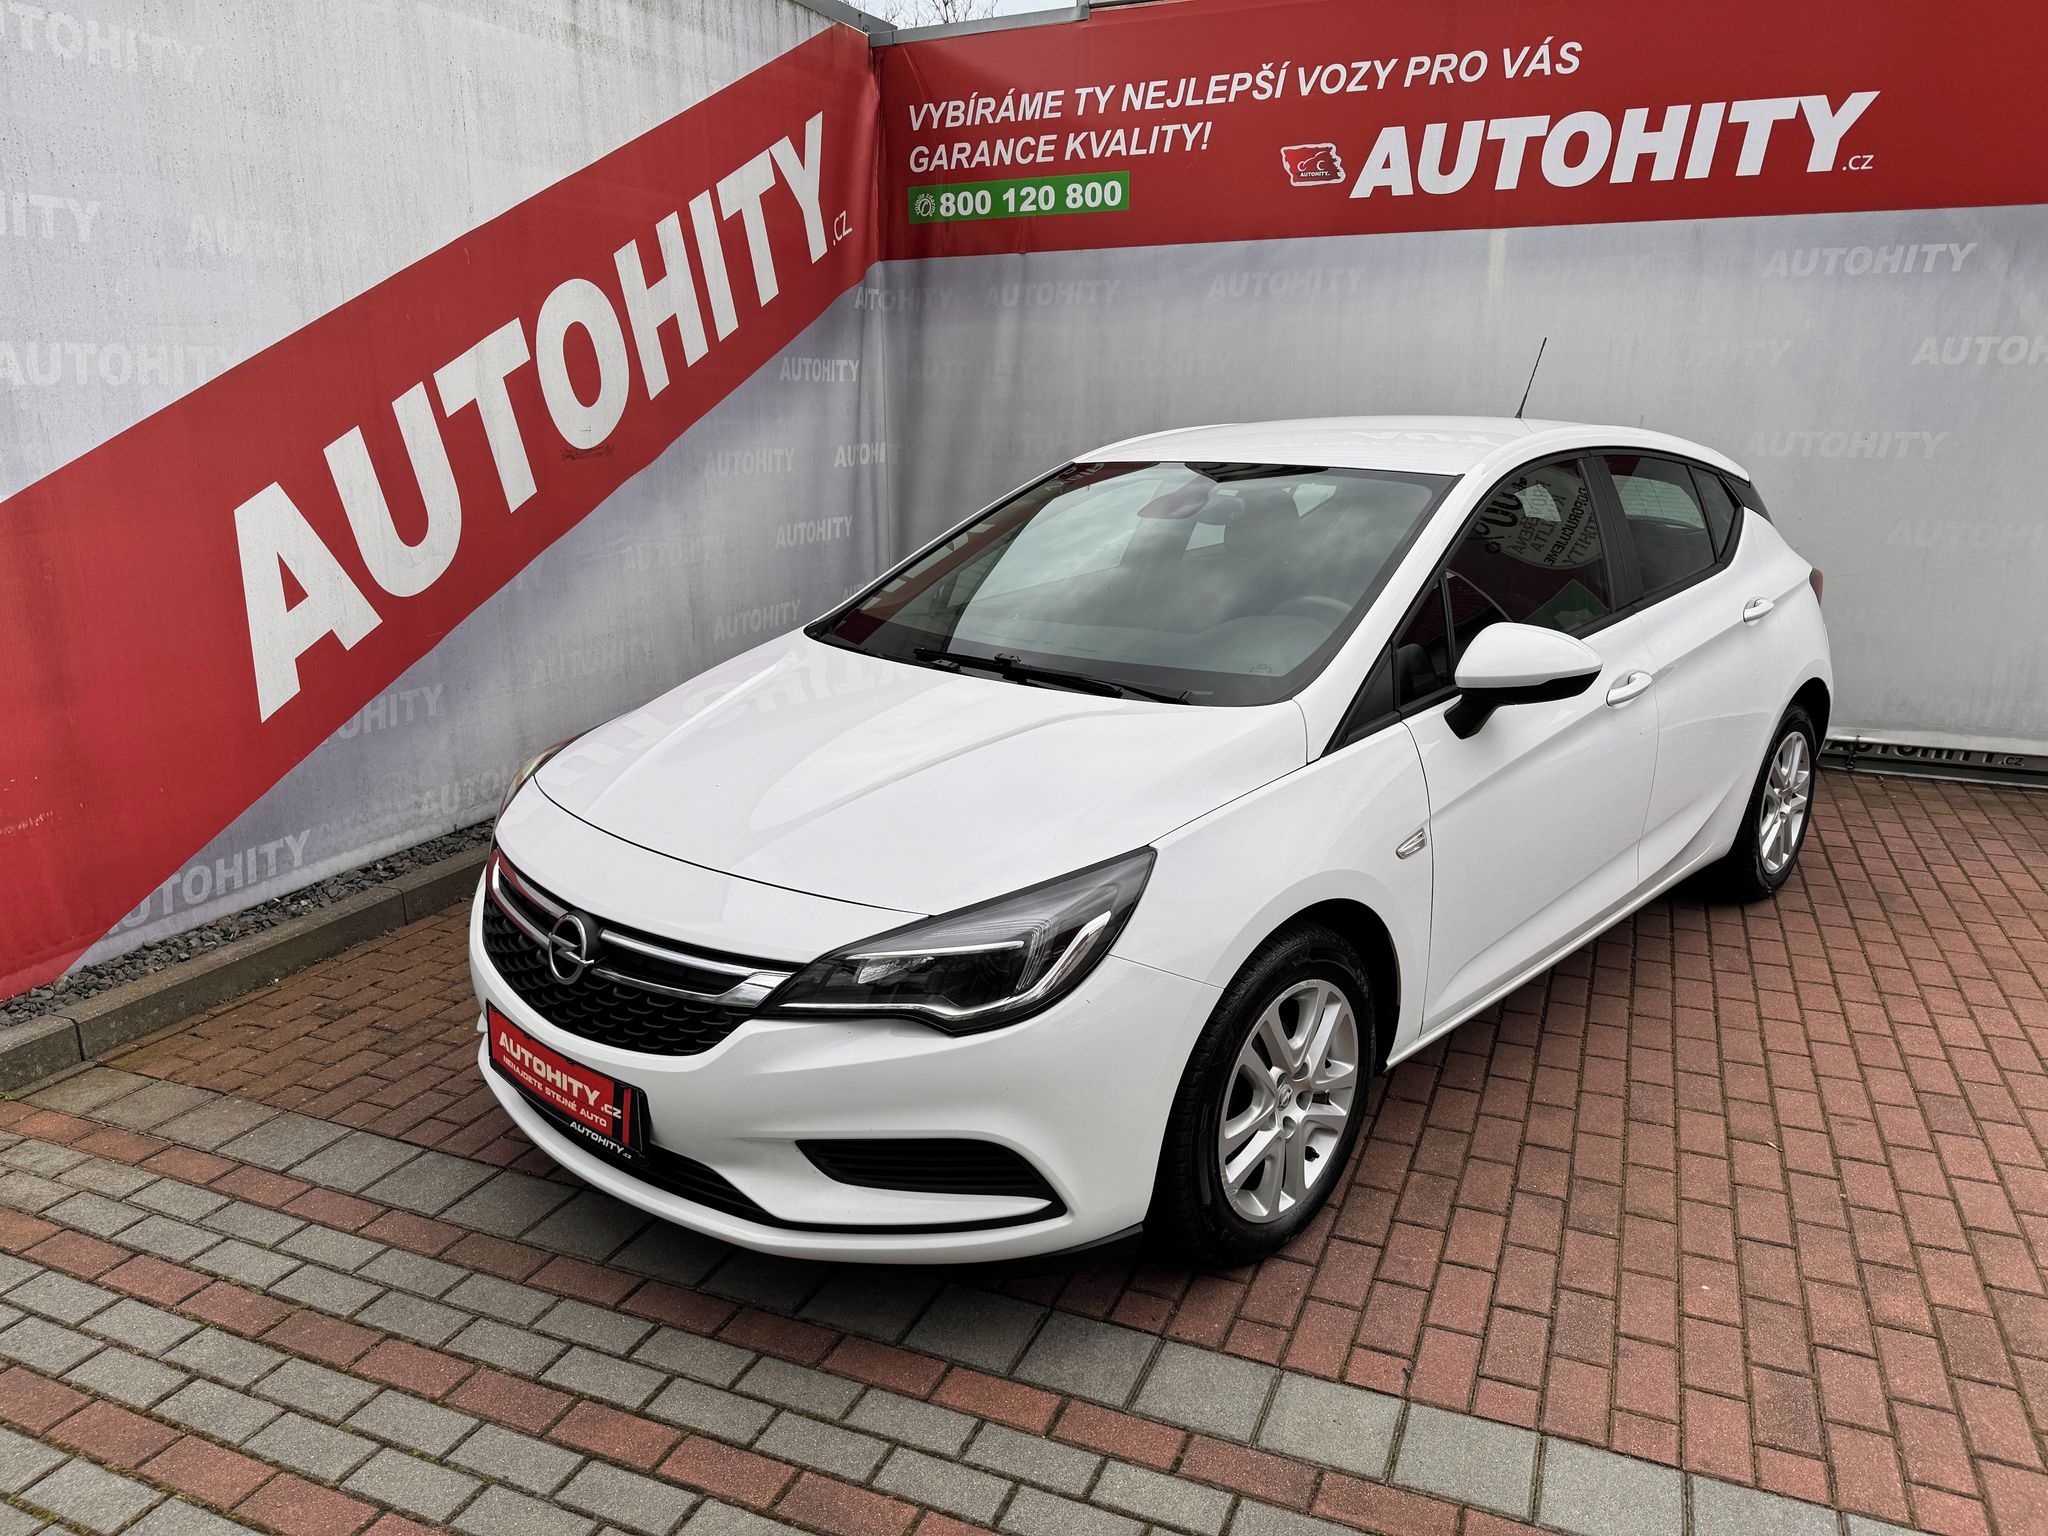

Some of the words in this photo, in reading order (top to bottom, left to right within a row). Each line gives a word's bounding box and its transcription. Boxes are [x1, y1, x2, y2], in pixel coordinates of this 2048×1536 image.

[908, 88, 1065, 132] VYBÍRÁME
[1074, 84, 1116, 116] TY
[1121, 61, 1291, 113] NEJLEPŠÍ
[1297, 58, 1399, 97] VOZY
[1403, 49, 1488, 88] PRO
[1502, 36, 1583, 79] VÁS
[908, 134, 1057, 173] GARANCE
[1064, 121, 1213, 161] KVALITY!
[939, 189, 992, 218] 800
[1002, 185, 1056, 213] 120
[1065, 180, 1123, 209] 800
[1762, 242, 1978, 278] AUTOHITY
[983, 278, 1122, 308] AUTOHITY
[1207, 263, 1369, 300] AUTOHITY
[779, 356, 860, 384] AUTOHITY
[1745, 431, 1949, 459] AUTOHITY
[703, 447, 797, 480] AUTOHITY
[774, 515, 854, 550] AUTOHITY
[713, 599, 803, 642] AUTOHITY
[579, 1108, 608, 1128] AUTO
